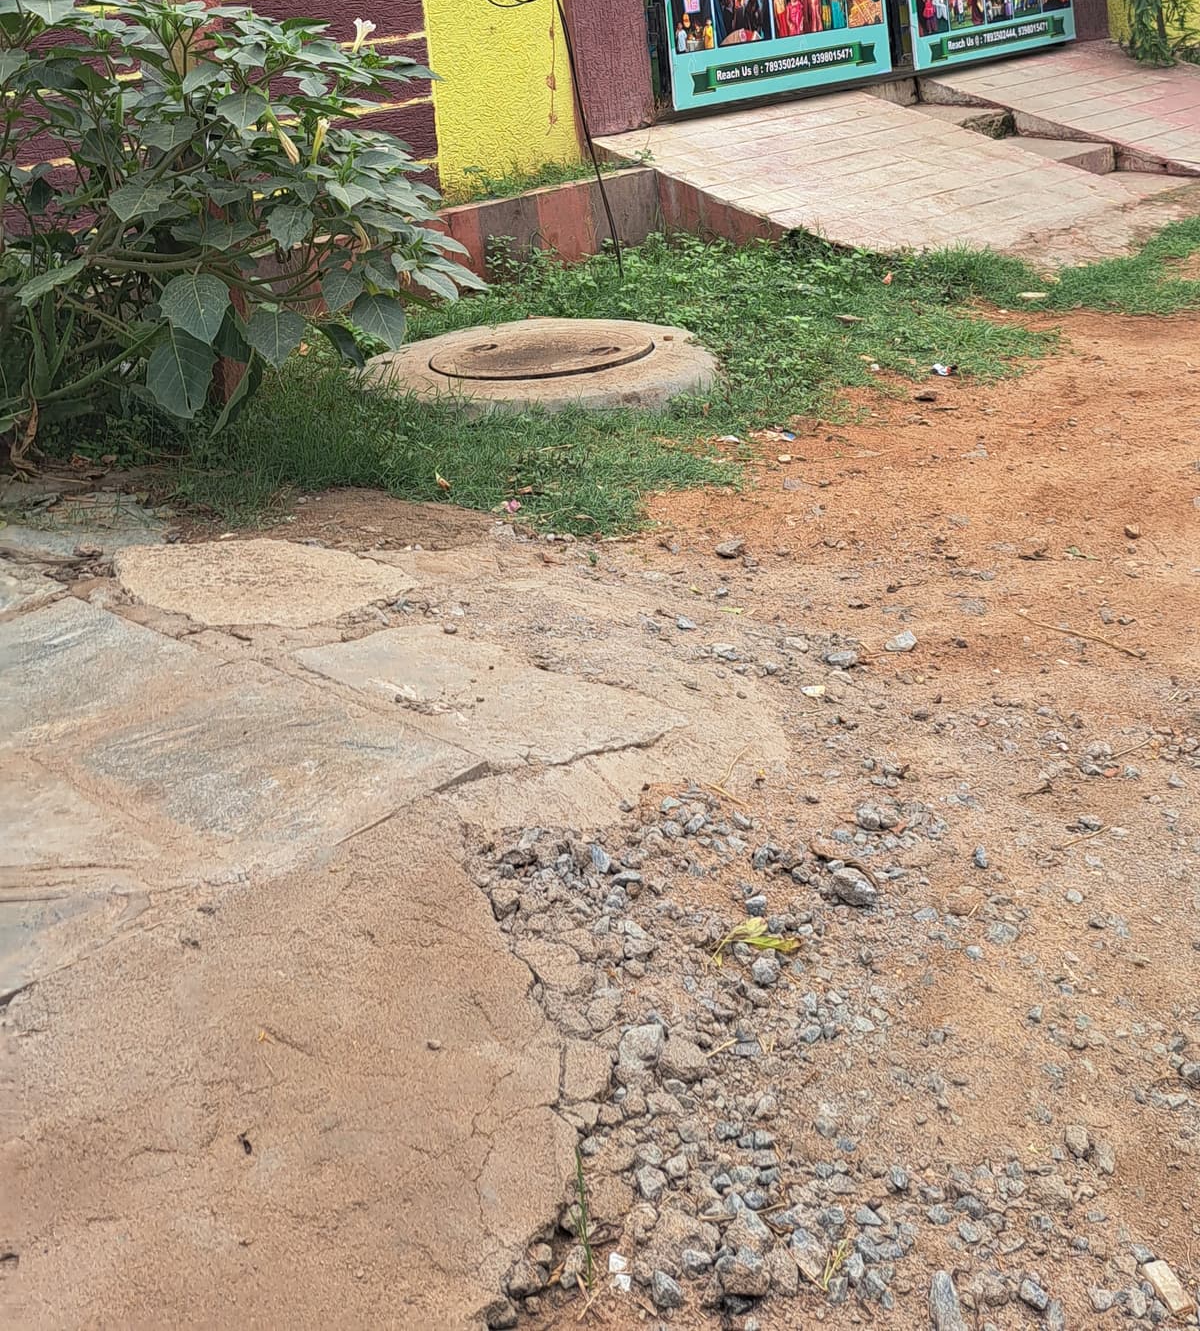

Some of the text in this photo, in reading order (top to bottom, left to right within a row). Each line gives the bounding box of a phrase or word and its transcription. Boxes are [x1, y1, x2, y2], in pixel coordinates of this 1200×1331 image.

[947, 39, 966, 50] Reach
[966, 37, 975, 47] Us
[716, 67, 740, 81] Reach
[741, 65, 752, 77] Us
[765, 56, 811, 73] 7893502444,
[811, 48, 853, 65] 9398015471
